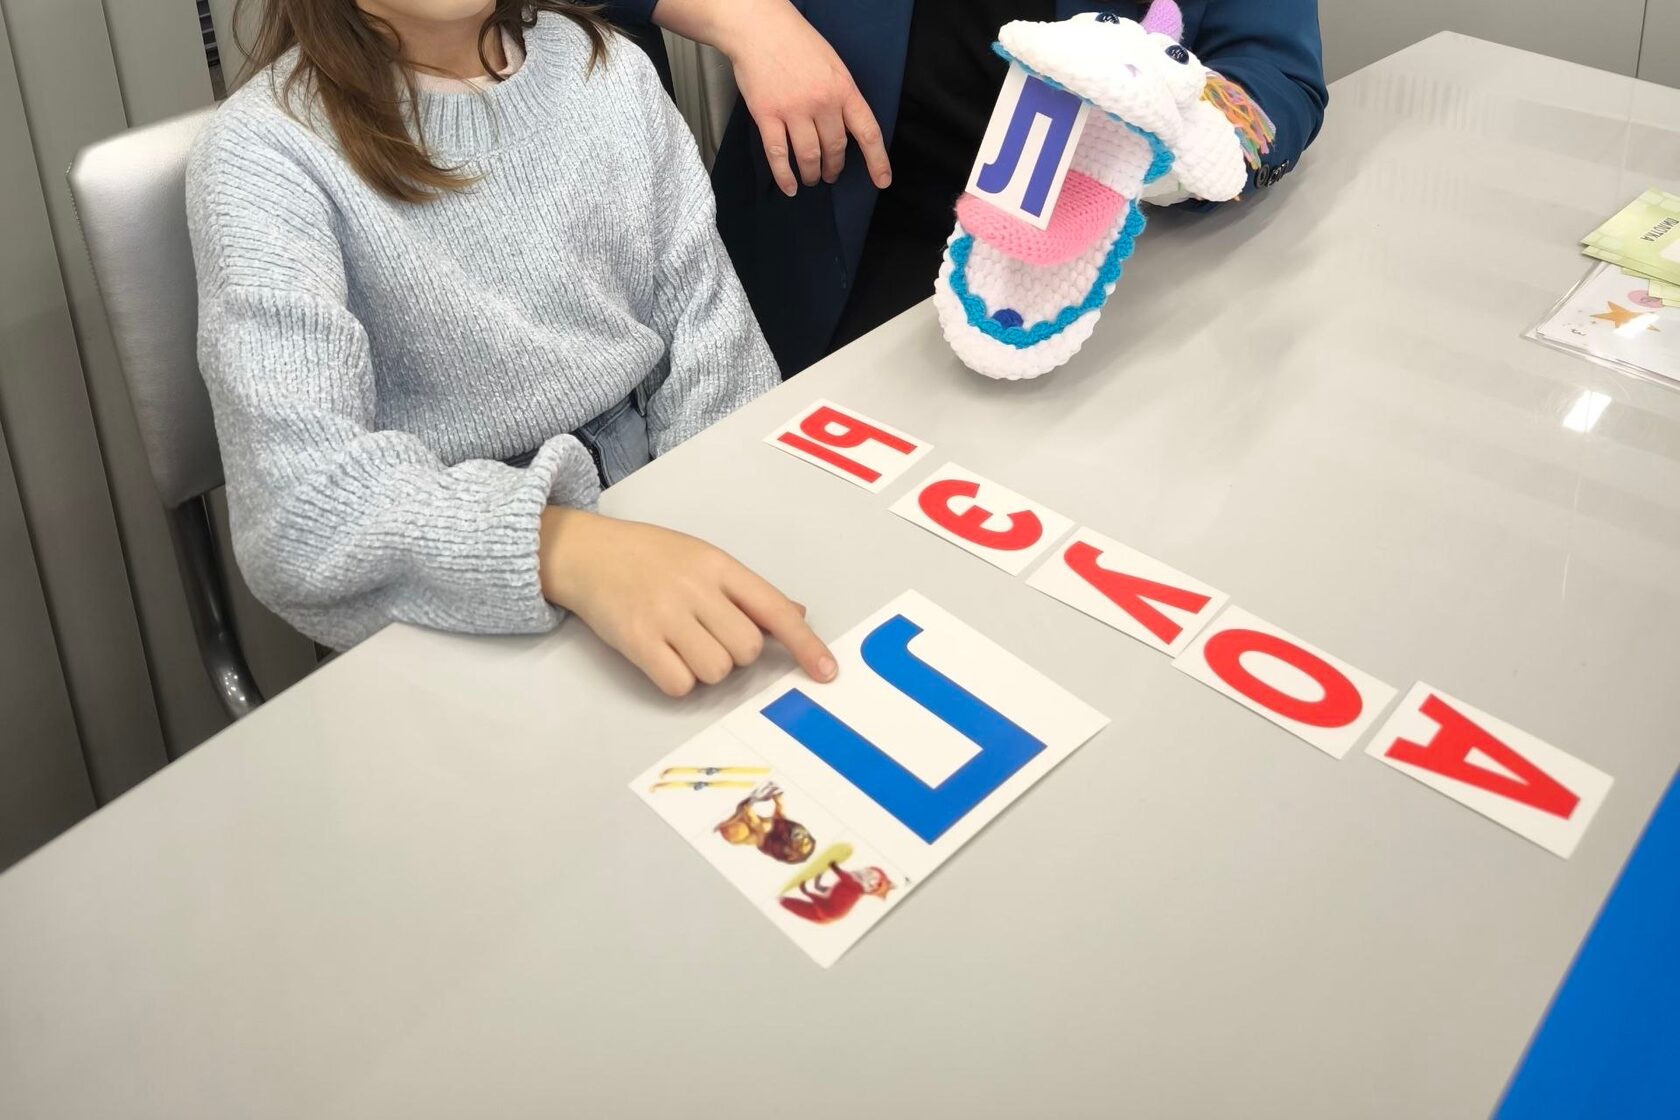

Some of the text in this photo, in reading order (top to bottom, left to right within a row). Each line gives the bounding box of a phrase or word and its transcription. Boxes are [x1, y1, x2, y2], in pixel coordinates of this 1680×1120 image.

[975, 74, 1082, 218] Л
[777, 405, 918, 484] Ы
[918, 479, 1043, 552] Э
[1063, 540, 1212, 646] У
[760, 613, 1047, 845] Л
[1202, 628, 1364, 729] О
[1384, 693, 1581, 821] А
